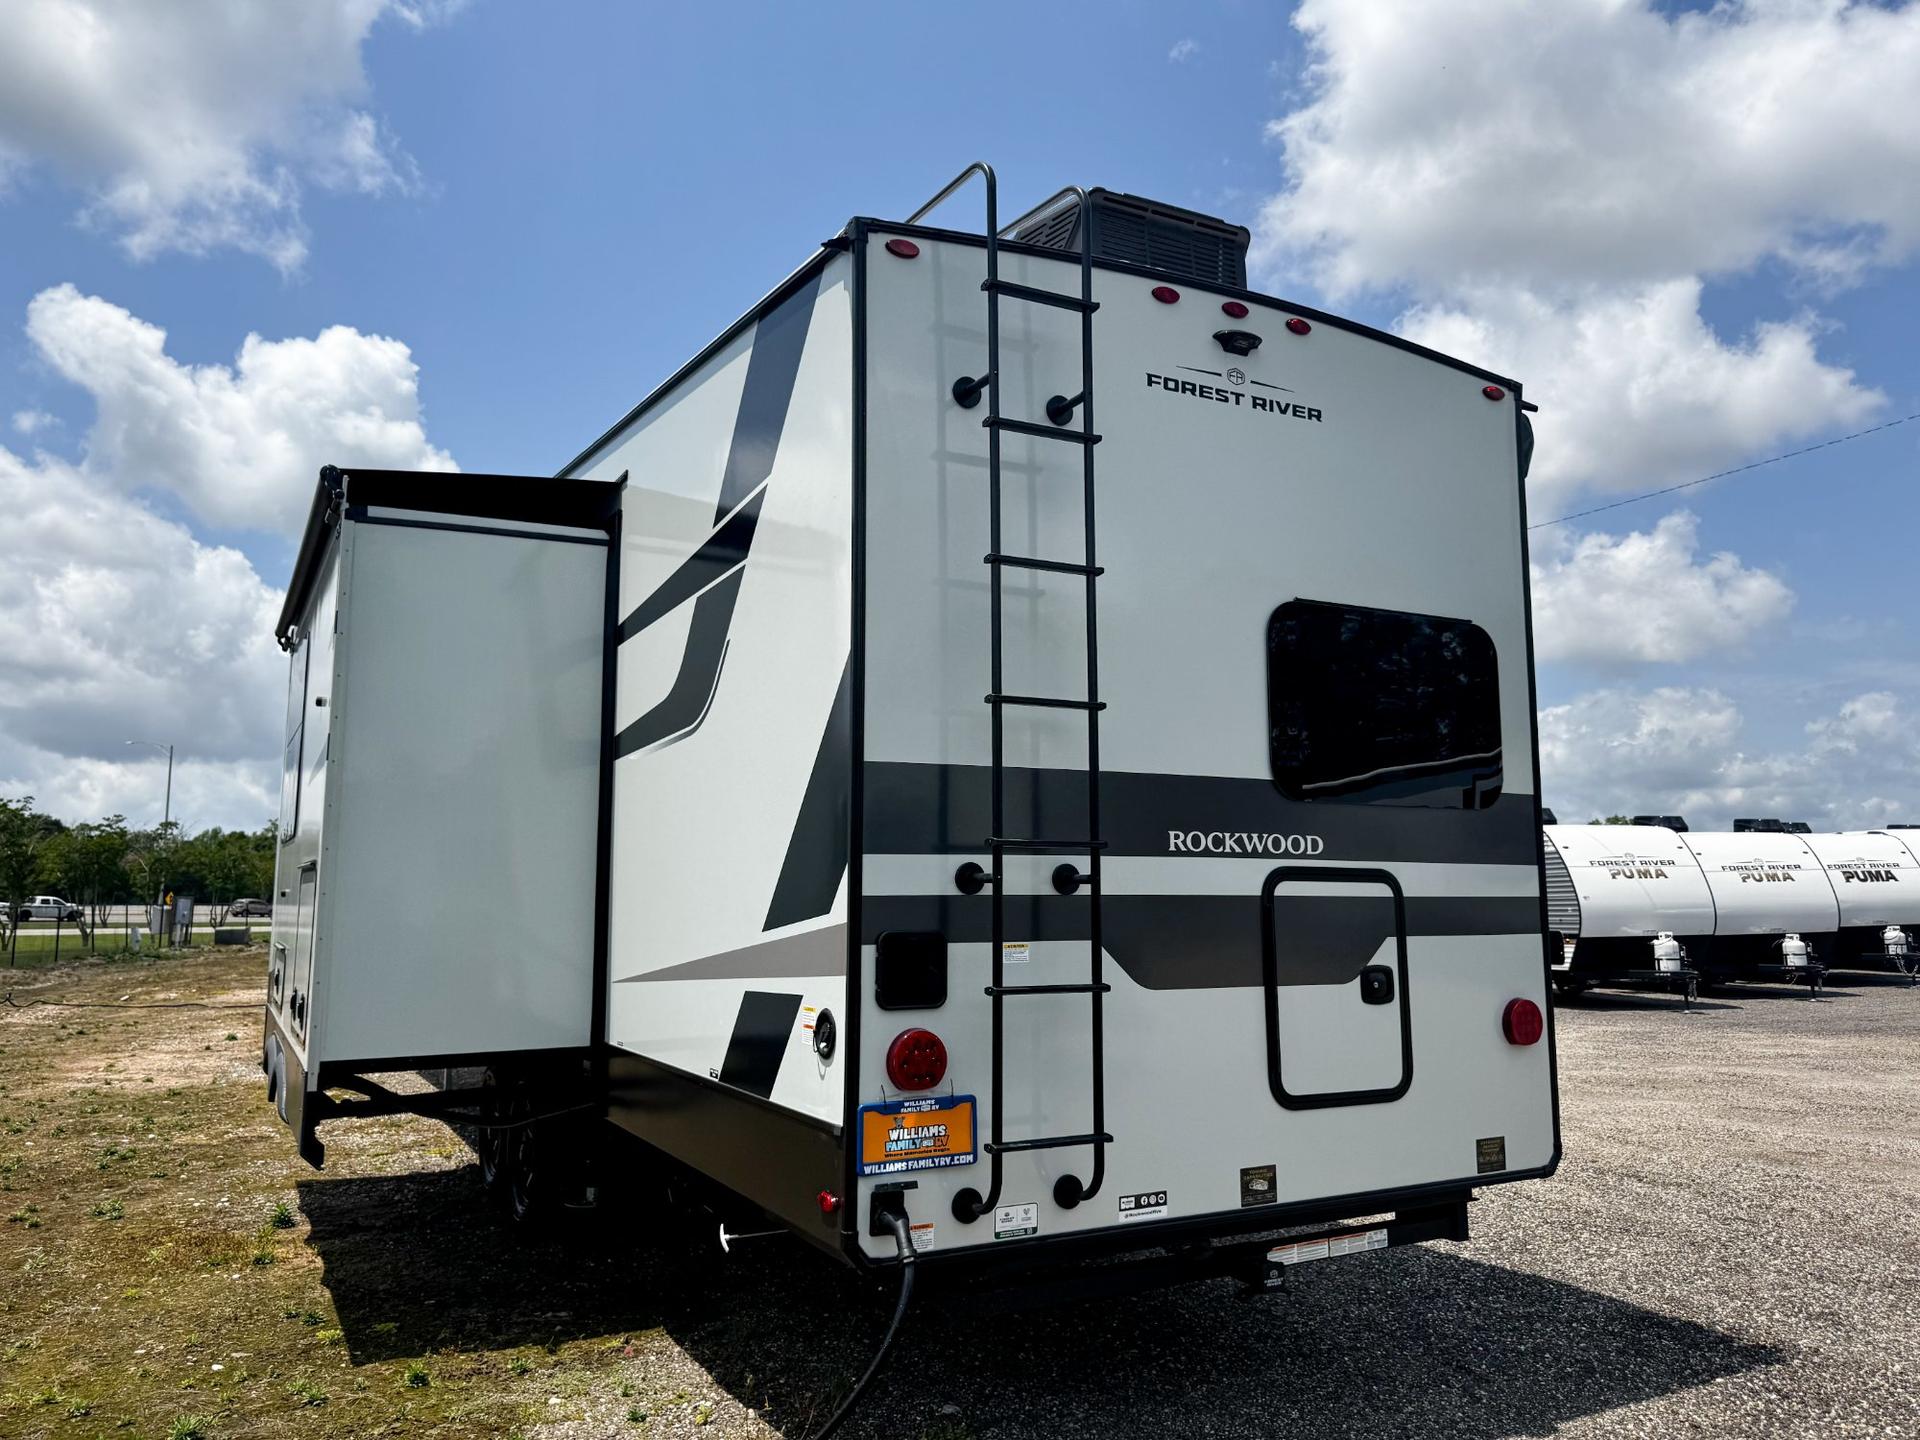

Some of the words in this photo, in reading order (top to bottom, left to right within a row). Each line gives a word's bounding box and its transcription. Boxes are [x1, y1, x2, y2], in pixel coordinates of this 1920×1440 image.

[1145, 372, 1245, 405] FOREST
[1251, 395, 1322, 422] RIVER
[1168, 831, 1324, 855] ROCKWOOD
[1608, 868, 1669, 880] PUMA
[1721, 864, 1765, 872] FOREST
[1739, 872, 1796, 883] PUMA
[1840, 869, 1900, 883] PUMA
[904, 1099, 935, 1107] WILLIAMS
[889, 1124, 947, 1141] WILLIAMS
[885, 1138, 921, 1152] FAMILY
[934, 1135, 950, 1148] RV
